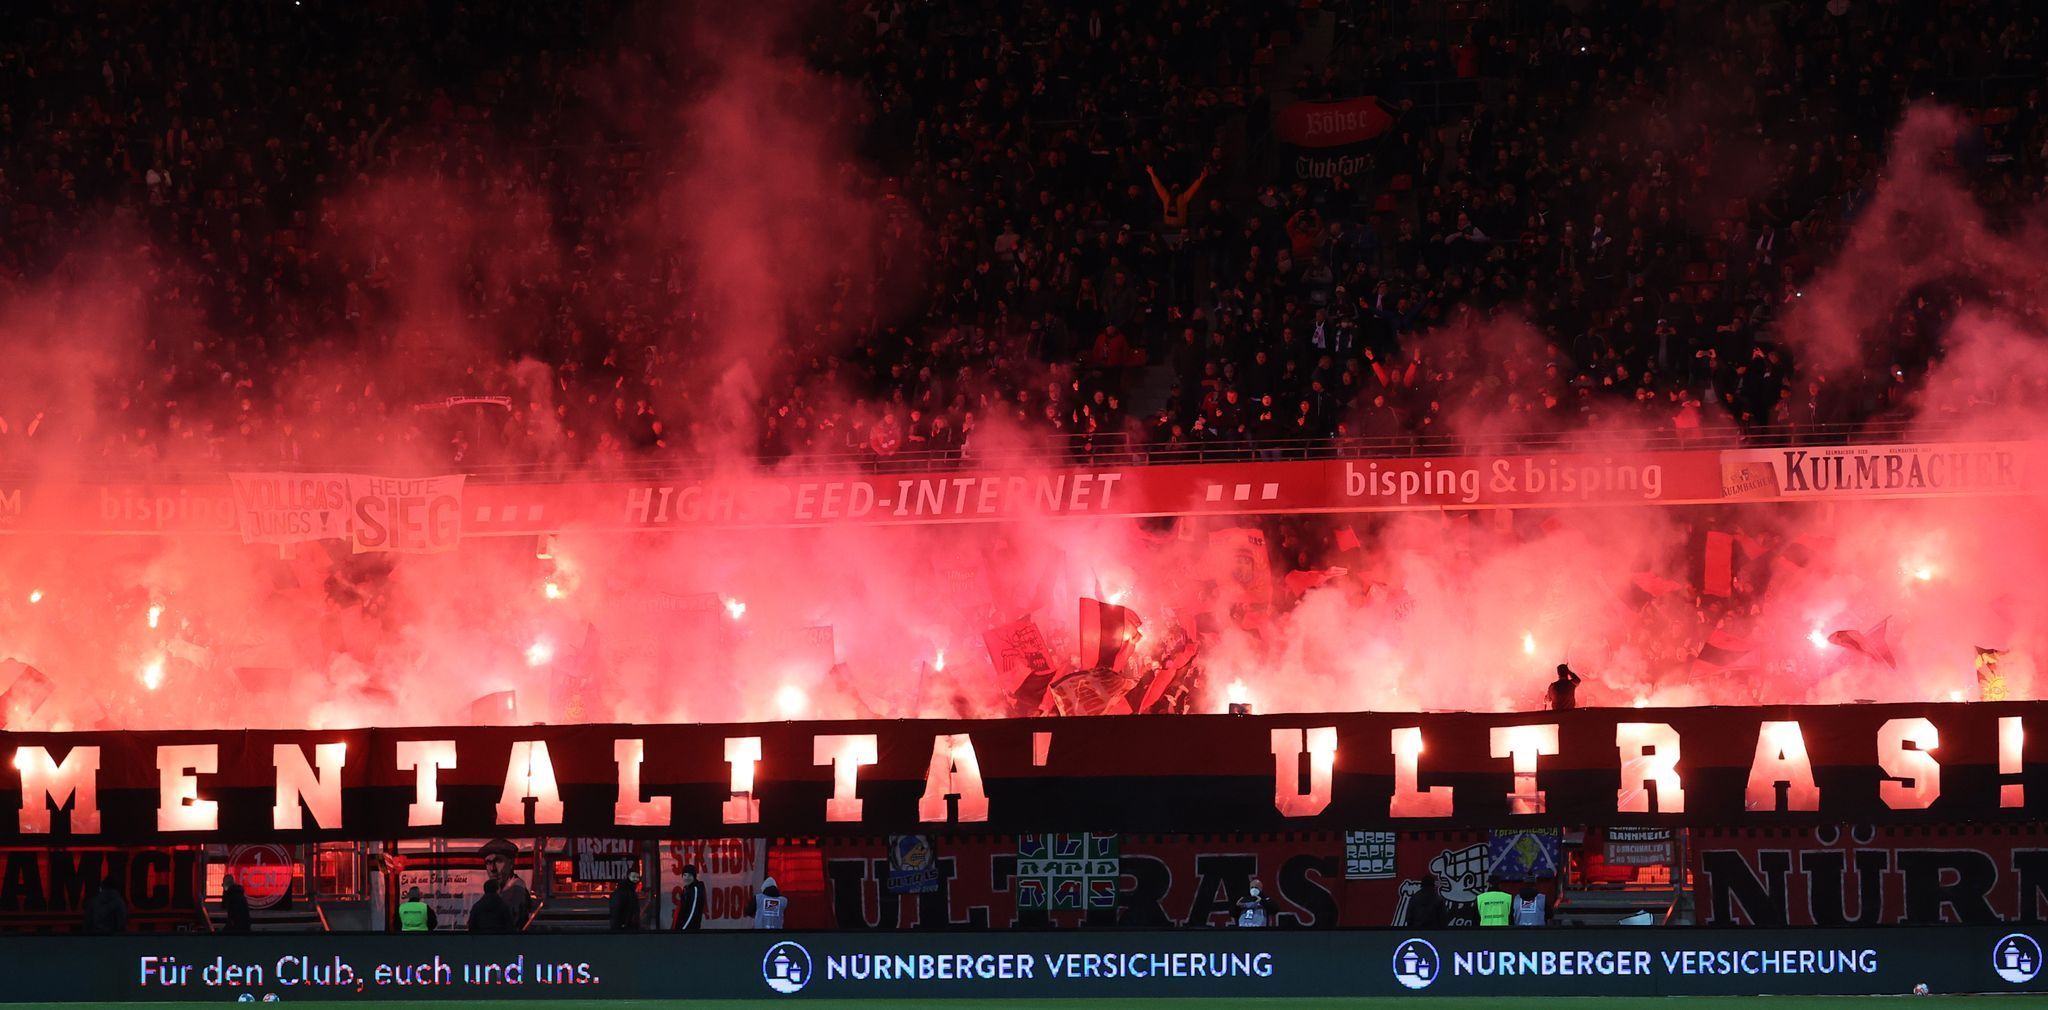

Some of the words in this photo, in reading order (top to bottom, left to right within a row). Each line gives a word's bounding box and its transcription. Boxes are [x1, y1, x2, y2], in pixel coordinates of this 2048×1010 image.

[1346, 461, 1480, 503] bisping
[1489, 459, 1517, 492] &
[1525, 457, 1663, 499] bisping
[1784, 450, 2018, 492] KULMBACHER
[234, 479, 344, 510] VOLLGAS
[368, 478, 439, 497] HEUTE
[624, 473, 1122, 524] HIGHEED-INTERNET
[247, 510, 312, 537] JUNGS
[355, 495, 460, 549] SIEG
[1269, 715, 2026, 818] ULTRAS!
[1345, 830, 1396, 843] LORDS
[670, 839, 755, 876] SEKTION
[1347, 858, 1394, 873] 2004
[239, 867, 277, 889] FCN
[140, 955, 192, 986] Für
[203, 955, 263, 986] den
[276, 955, 364, 992] Club,
[374, 954, 452, 986] euch
[463, 954, 524, 986] und
[536, 962, 600, 986] uns.
[827, 953, 1034, 981] NÜRNBERGER
[1045, 952, 1273, 978] VERSICHERUNG
[1453, 950, 1651, 976] NÜRNBERGER
[1660, 949, 1879, 975] VERSICHERUNG
